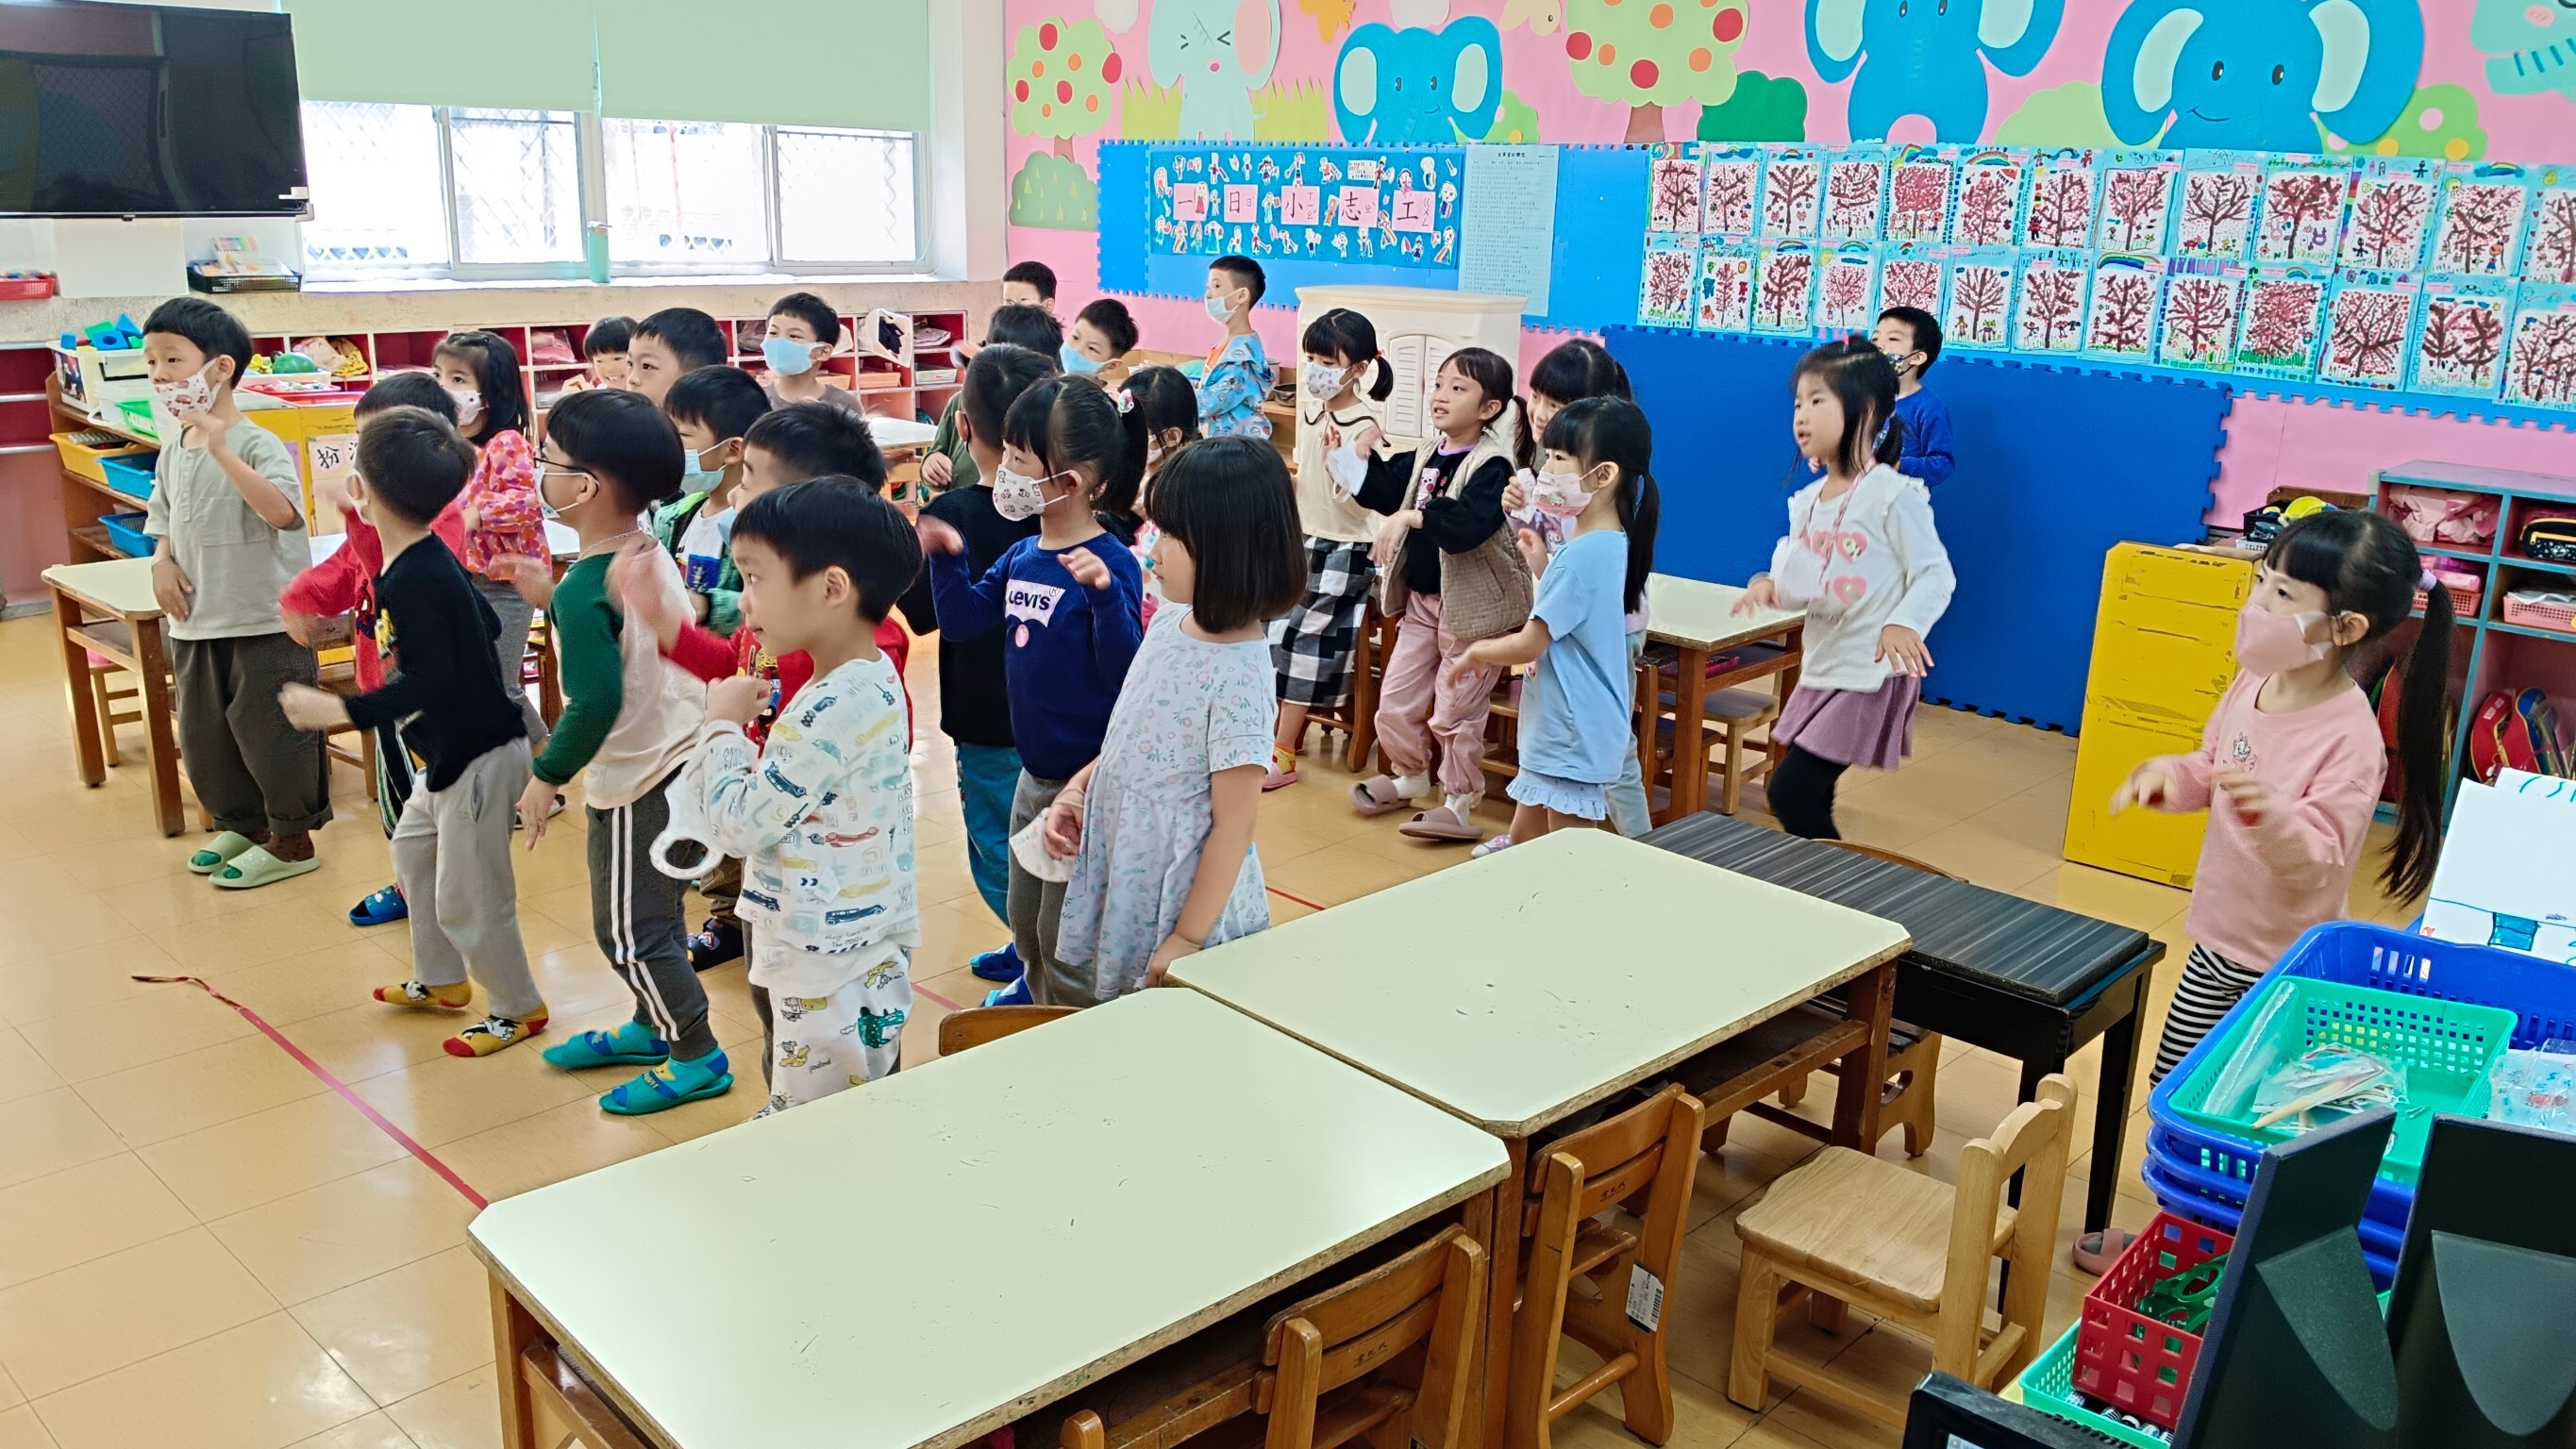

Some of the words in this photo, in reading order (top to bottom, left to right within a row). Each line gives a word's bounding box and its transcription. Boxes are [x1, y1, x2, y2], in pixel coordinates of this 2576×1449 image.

[1229, 191, 1241, 214] 日
[1283, 192, 1304, 219] 小
[1340, 191, 1362, 221] 志
[1396, 201, 1419, 221] 工
